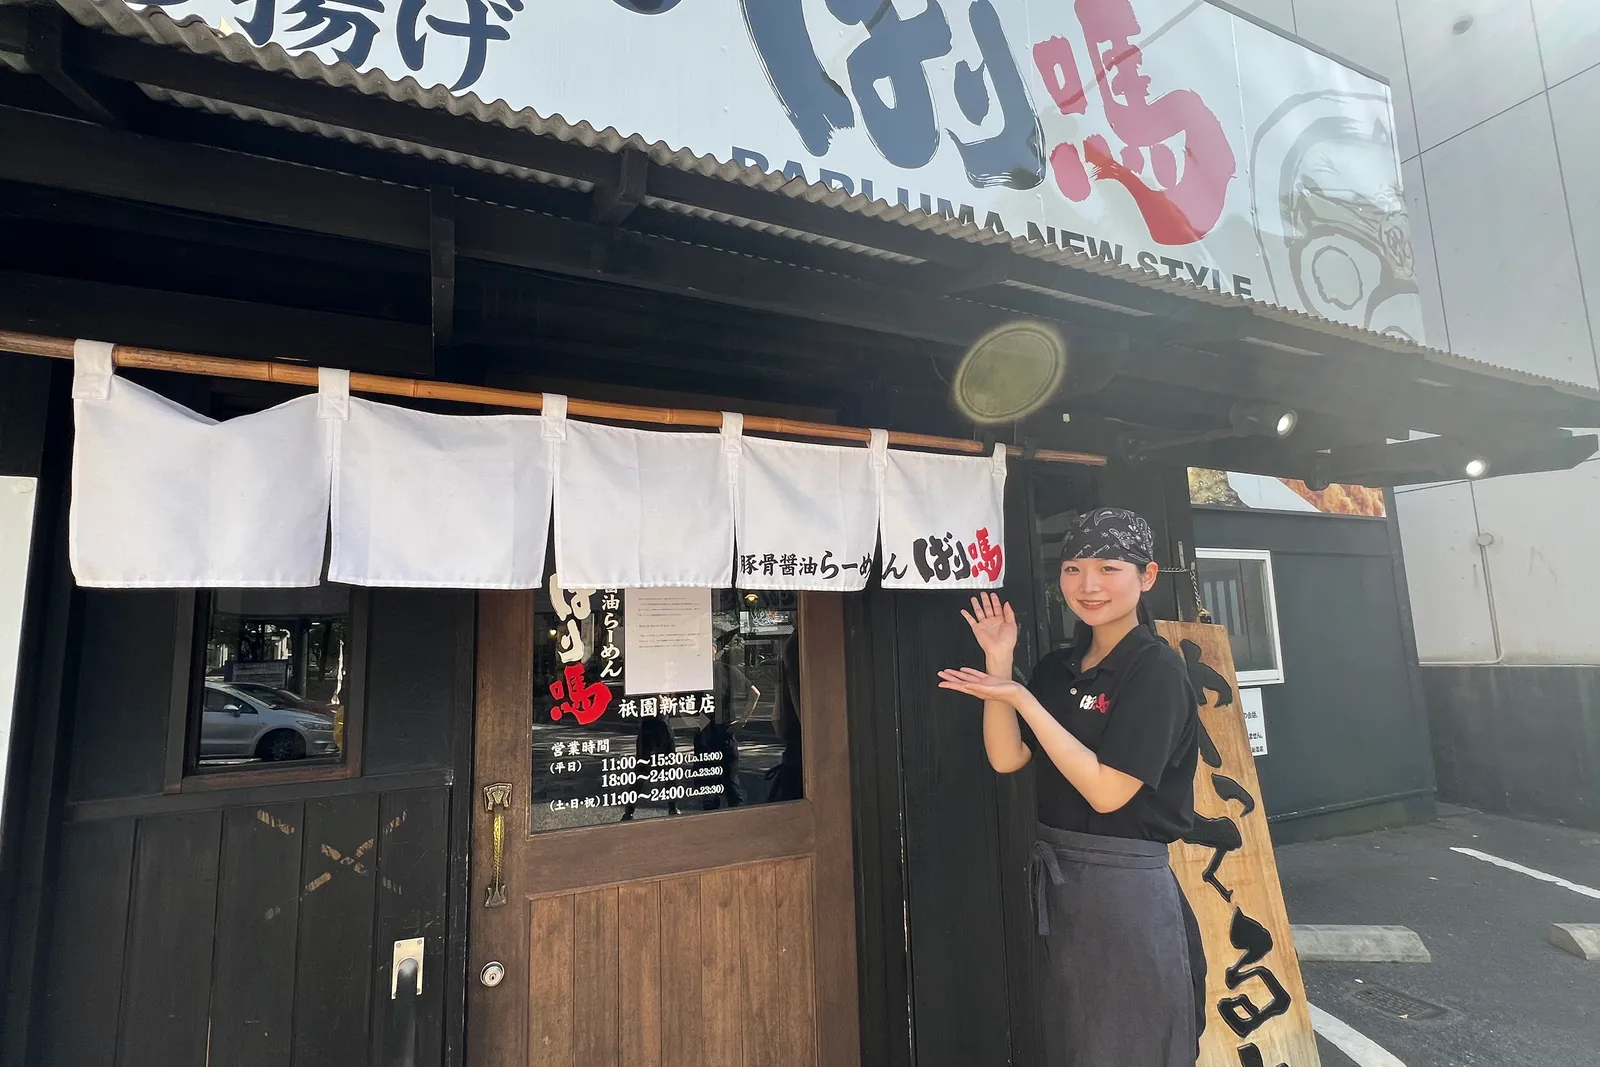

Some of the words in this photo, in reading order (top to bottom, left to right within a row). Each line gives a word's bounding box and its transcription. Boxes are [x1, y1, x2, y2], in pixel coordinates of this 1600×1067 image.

[600, 588, 623, 678] 油らーめん
[618, 694, 715, 718] 祇園新道店
[551, 739, 610, 757] 営業時間
[550, 760, 583, 774] (平日)
